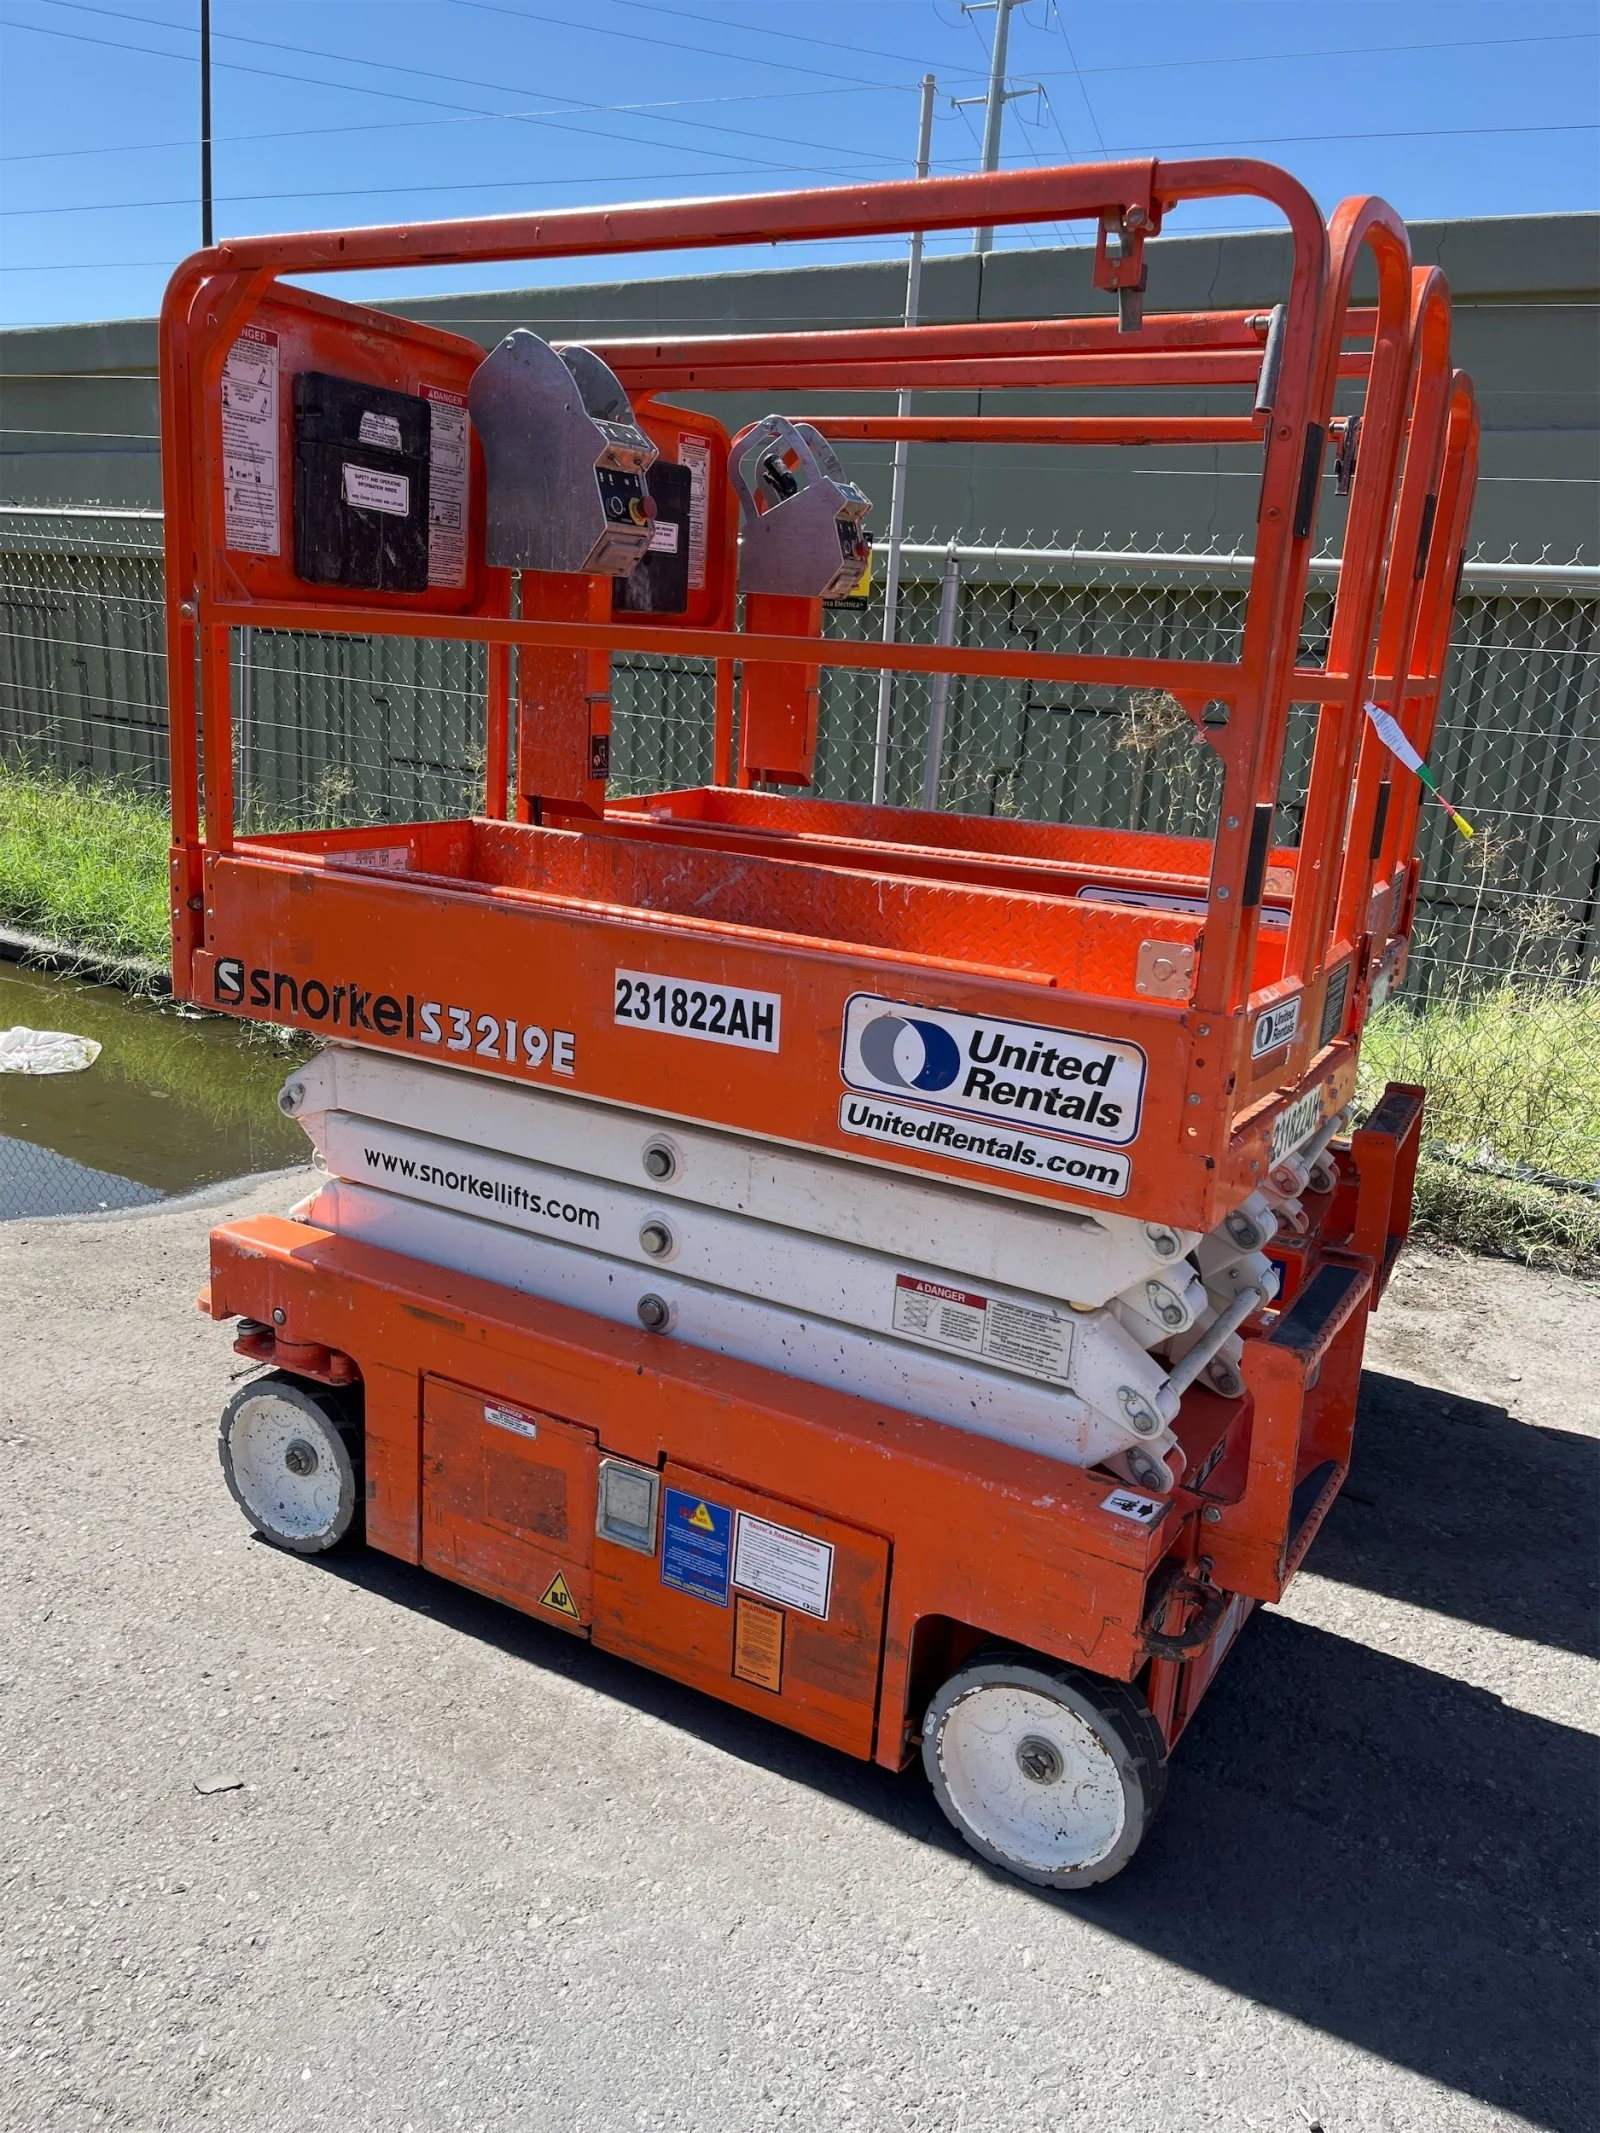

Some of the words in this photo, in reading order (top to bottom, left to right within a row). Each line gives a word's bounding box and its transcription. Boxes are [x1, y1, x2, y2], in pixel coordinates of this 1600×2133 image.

[241, 328, 267, 342] NGER
[433, 391, 463, 406] DANGER
[250, 968, 415, 1040] snorkel
[419, 1001, 576, 1078] S3219E
[616, 979, 774, 1042] 231822AH
[1274, 1005, 1296, 1027] United
[967, 1030, 1118, 1087] United
[962, 1066, 1122, 1128] Rentals
[847, 1103, 1120, 1186] UnitedRentals.com
[364, 1148, 600, 1230] www.snorkellifts.com
[924, 1283, 966, 1302] DANGER
[742, 1602, 778, 1620] WARNING
